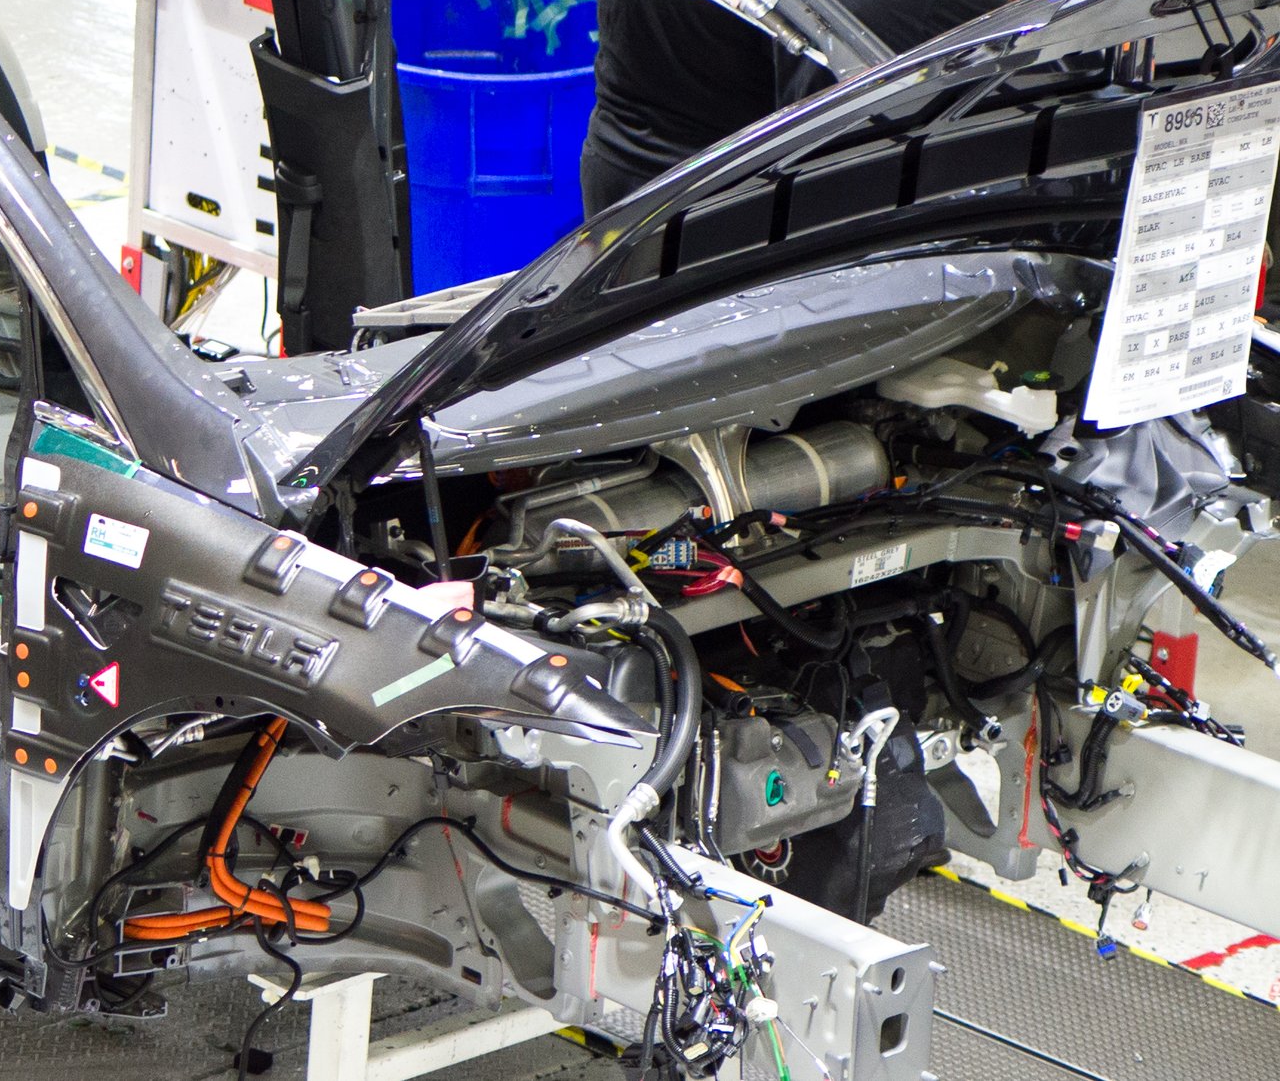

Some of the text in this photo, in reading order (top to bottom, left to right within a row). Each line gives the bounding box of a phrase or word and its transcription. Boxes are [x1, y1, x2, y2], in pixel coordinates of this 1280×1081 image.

[1144, 135, 1273, 174] HVAC LH BASE MX LH
[1141, 174, 1231, 204] BASE HVAC HVAC
[1208, 237, 1216, 247] X
[1135, 282, 1147, 293] LH
[1124, 311, 1149, 325] HVAC
[1157, 307, 1165, 317] X
[1177, 302, 1189, 312] LH
[1152, 337, 1160, 348] X
[1168, 330, 1190, 344] PASS
[1218, 320, 1225, 331] X
[91, 526, 107, 540] RH
[160, 586, 339, 686] TESLA
